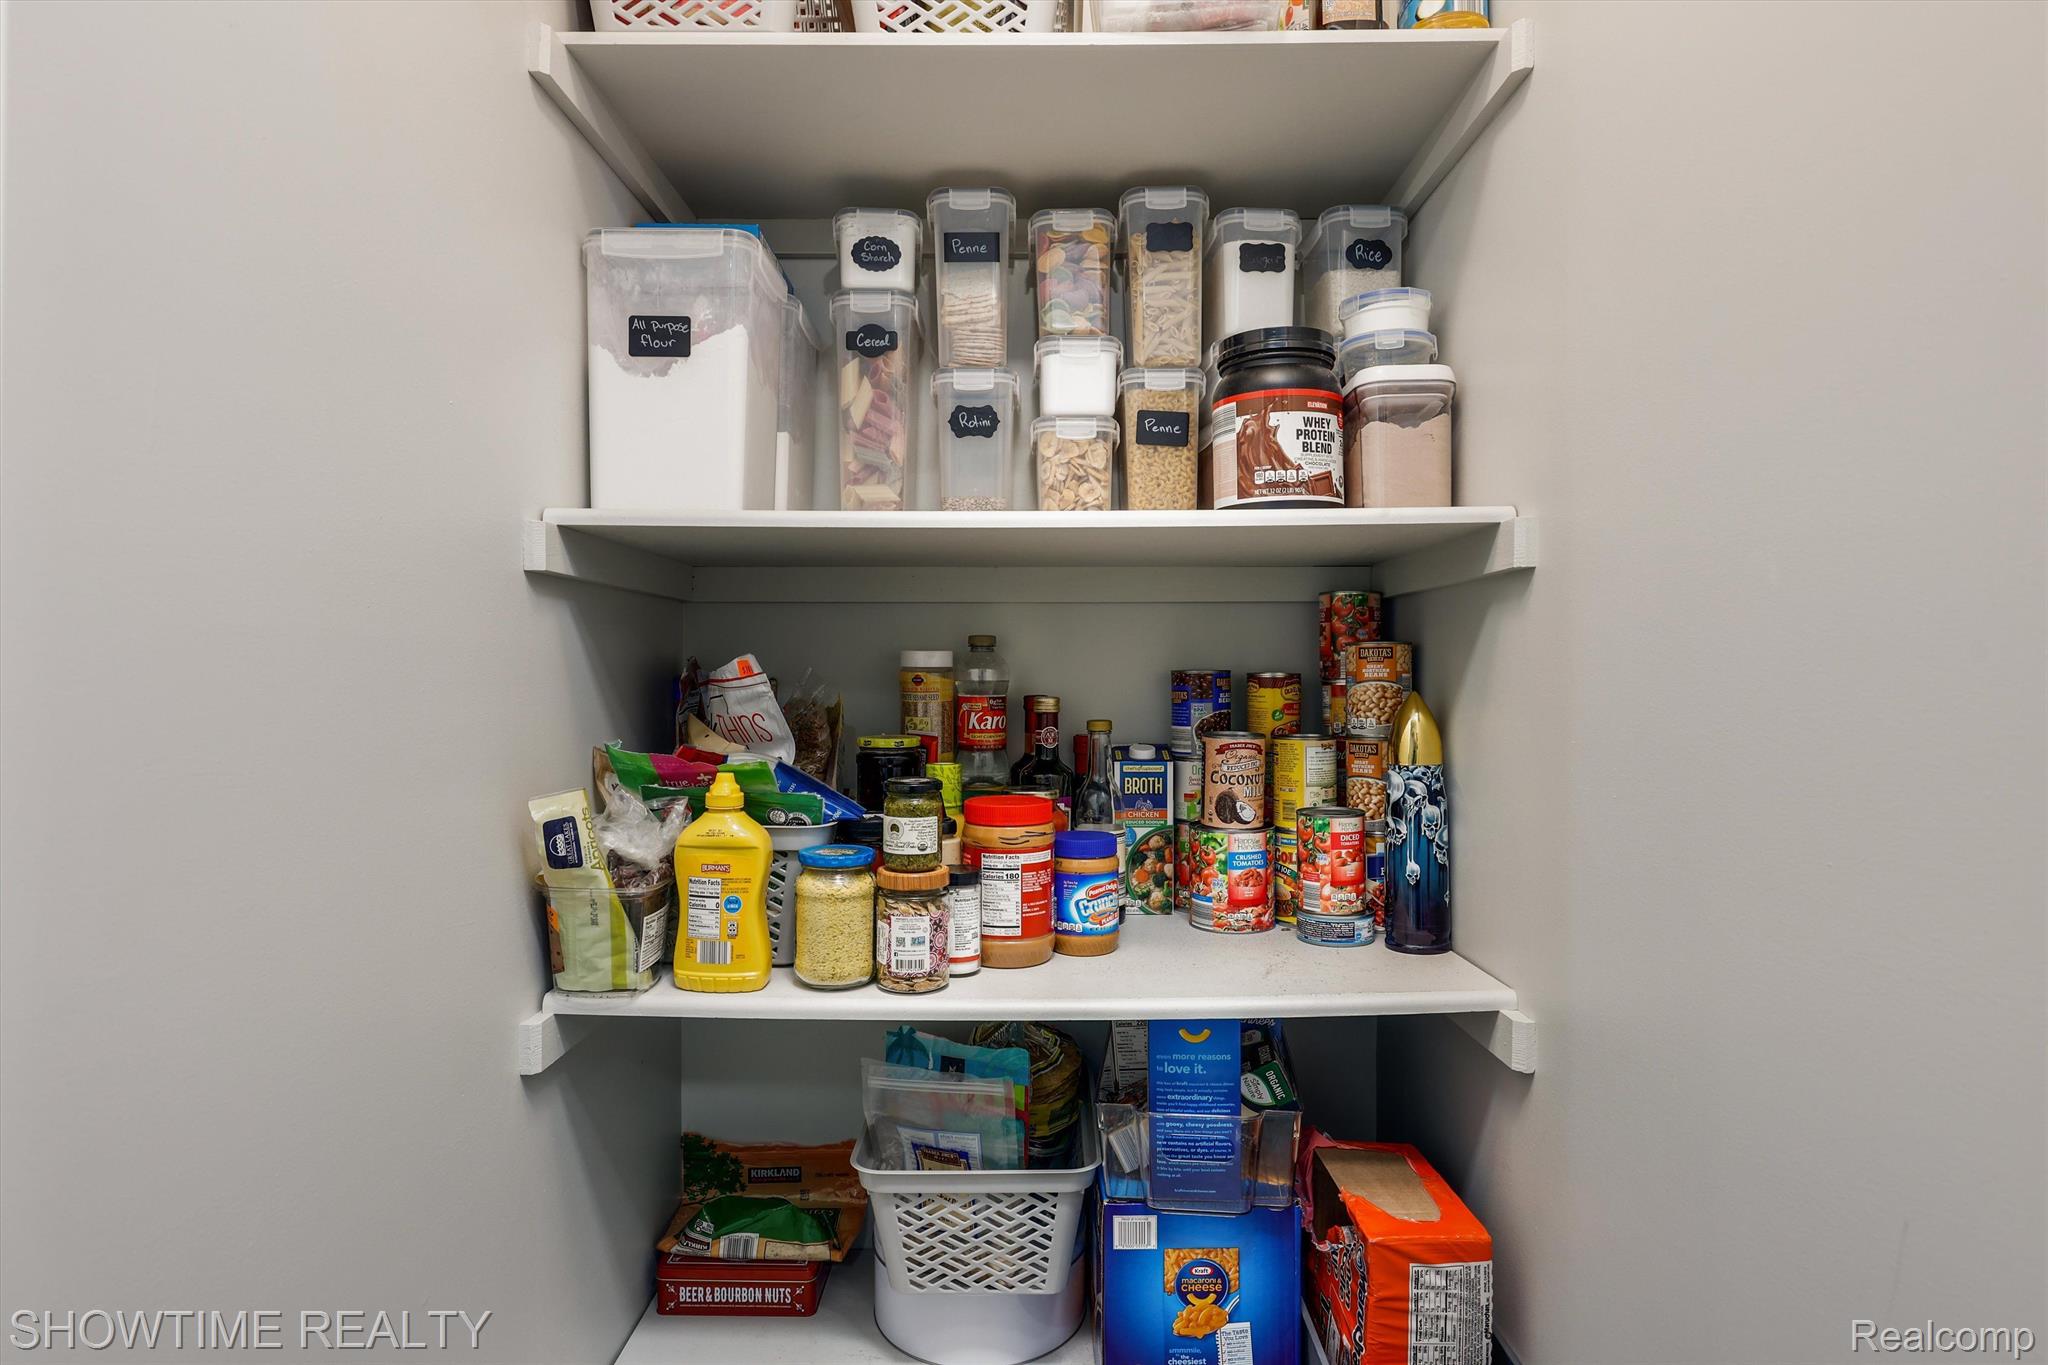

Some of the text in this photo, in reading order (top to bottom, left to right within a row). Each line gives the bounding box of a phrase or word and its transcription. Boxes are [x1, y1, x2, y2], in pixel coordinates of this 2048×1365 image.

[863, 241, 888, 252] Corn
[951, 240, 989, 256] Penne
[1354, 243, 1383, 263] Rice
[861, 251, 896, 264] Starch
[631, 319, 691, 336] All purpose
[640, 334, 677, 349] flour
[855, 333, 892, 348] Cereal
[958, 413, 992, 429] Rotini
[1144, 418, 1182, 435] Penne
[1302, 416, 1332, 430] WHEY
[1295, 428, 1336, 443] PROTEIN
[1301, 441, 1333, 455] BLEND
[1360, 648, 1392, 657] DAKOTA'S
[716, 713, 773, 742] THINS
[968, 711, 1007, 730] Karo
[1210, 769, 1265, 786] COCONUT
[1124, 776, 1163, 795] BROTH
[1243, 786, 1265, 799] MIL
[1340, 833, 1360, 842] DICED
[1232, 859, 1264, 867] TOMATOES
[1235, 853, 1262, 861] CRUSHED
[701, 864, 730, 873] BURMAN'S
[1005, 872, 1020, 880] 180
[715, 901, 721, 909] 0
[1172, 1053, 1196, 1061] more
[1197, 1053, 1232, 1061] reasons
[1164, 1061, 1191, 1074] love
[1194, 1063, 1207, 1075] it.
[1250, 1078, 1265, 1100] Simply
[1265, 1070, 1286, 1100] ORGANIC
[1167, 1093, 1213, 1102] extraordinary
[751, 1168, 800, 1178] KIRKLAND
[683, 1240, 708, 1250] KIRKL
[679, 1286, 792, 1304] BEER & BOURBON NUTS
[1352, 1272, 1368, 1365] Marucha
[1167, 1357, 1207, 1365] cheesiest
